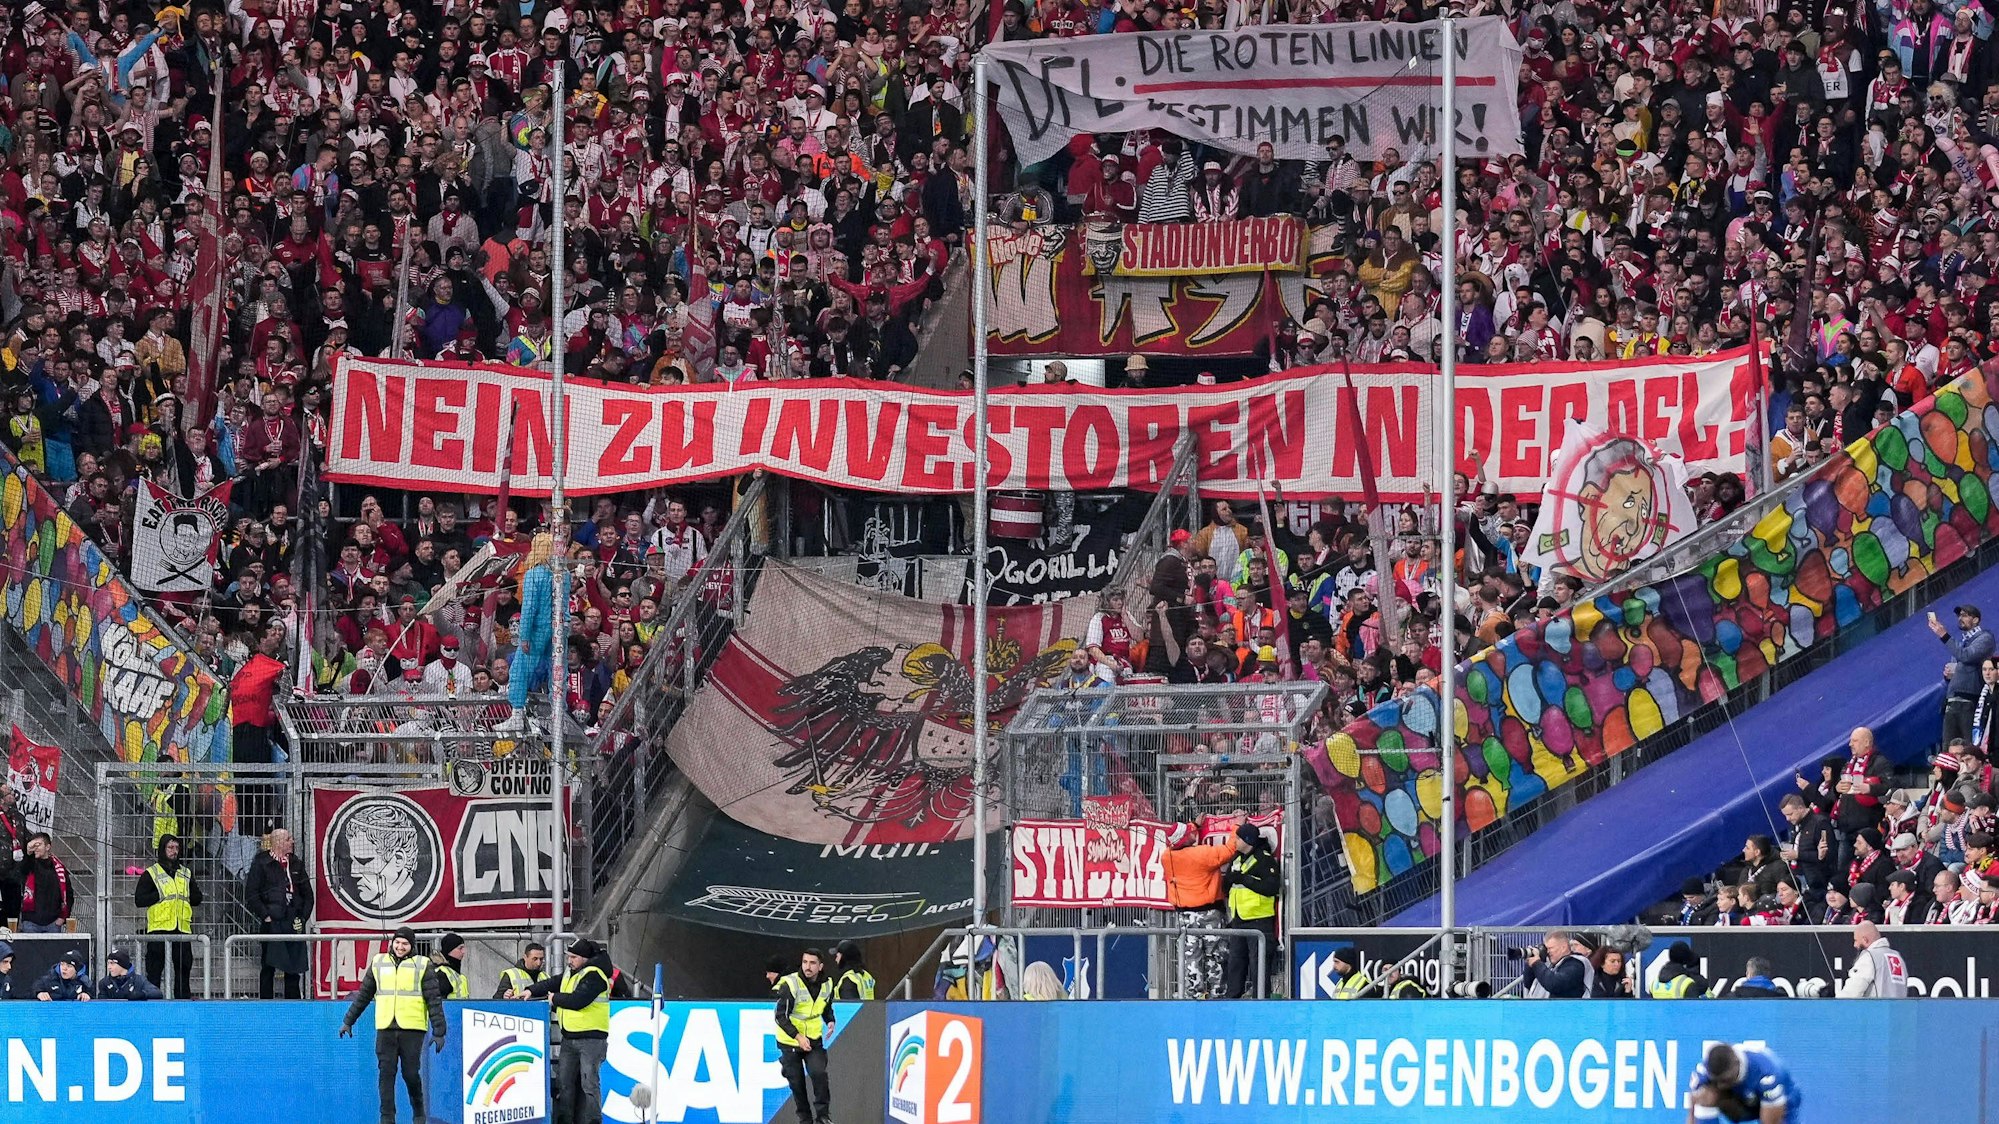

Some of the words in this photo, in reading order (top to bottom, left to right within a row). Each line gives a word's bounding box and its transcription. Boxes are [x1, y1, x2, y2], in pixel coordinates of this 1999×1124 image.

[1136, 34, 1195, 76] DIE
[1209, 32, 1334, 71] ROTEN
[1348, 28, 1468, 65] LINIEN
[1147, 97, 1371, 146] ESTIMMEN
[1391, 103, 1487, 151] WIR!
[340, 369, 570, 477] NEIN
[598, 397, 718, 477] ZU
[738, 389, 1306, 490] INVESTOREN
[1331, 385, 1419, 478] IN
[1452, 381, 1588, 478] DER
[142, 499, 167, 530] EAT
[490, 776, 525, 795] CON
[491, 760, 552, 775] DIFFIDA
[462, 810, 567, 895] CNS
[806, 913, 889, 924] zero
[922, 897, 974, 915] Aren
[473, 1011, 534, 1034] RADIO
[602, 1006, 795, 1123] SAP
[937, 1019, 973, 1123] 2
[1167, 1036, 1766, 1110] WWW.REGENBOGEN.
[475, 1105, 535, 1124] REGENBOGEN
